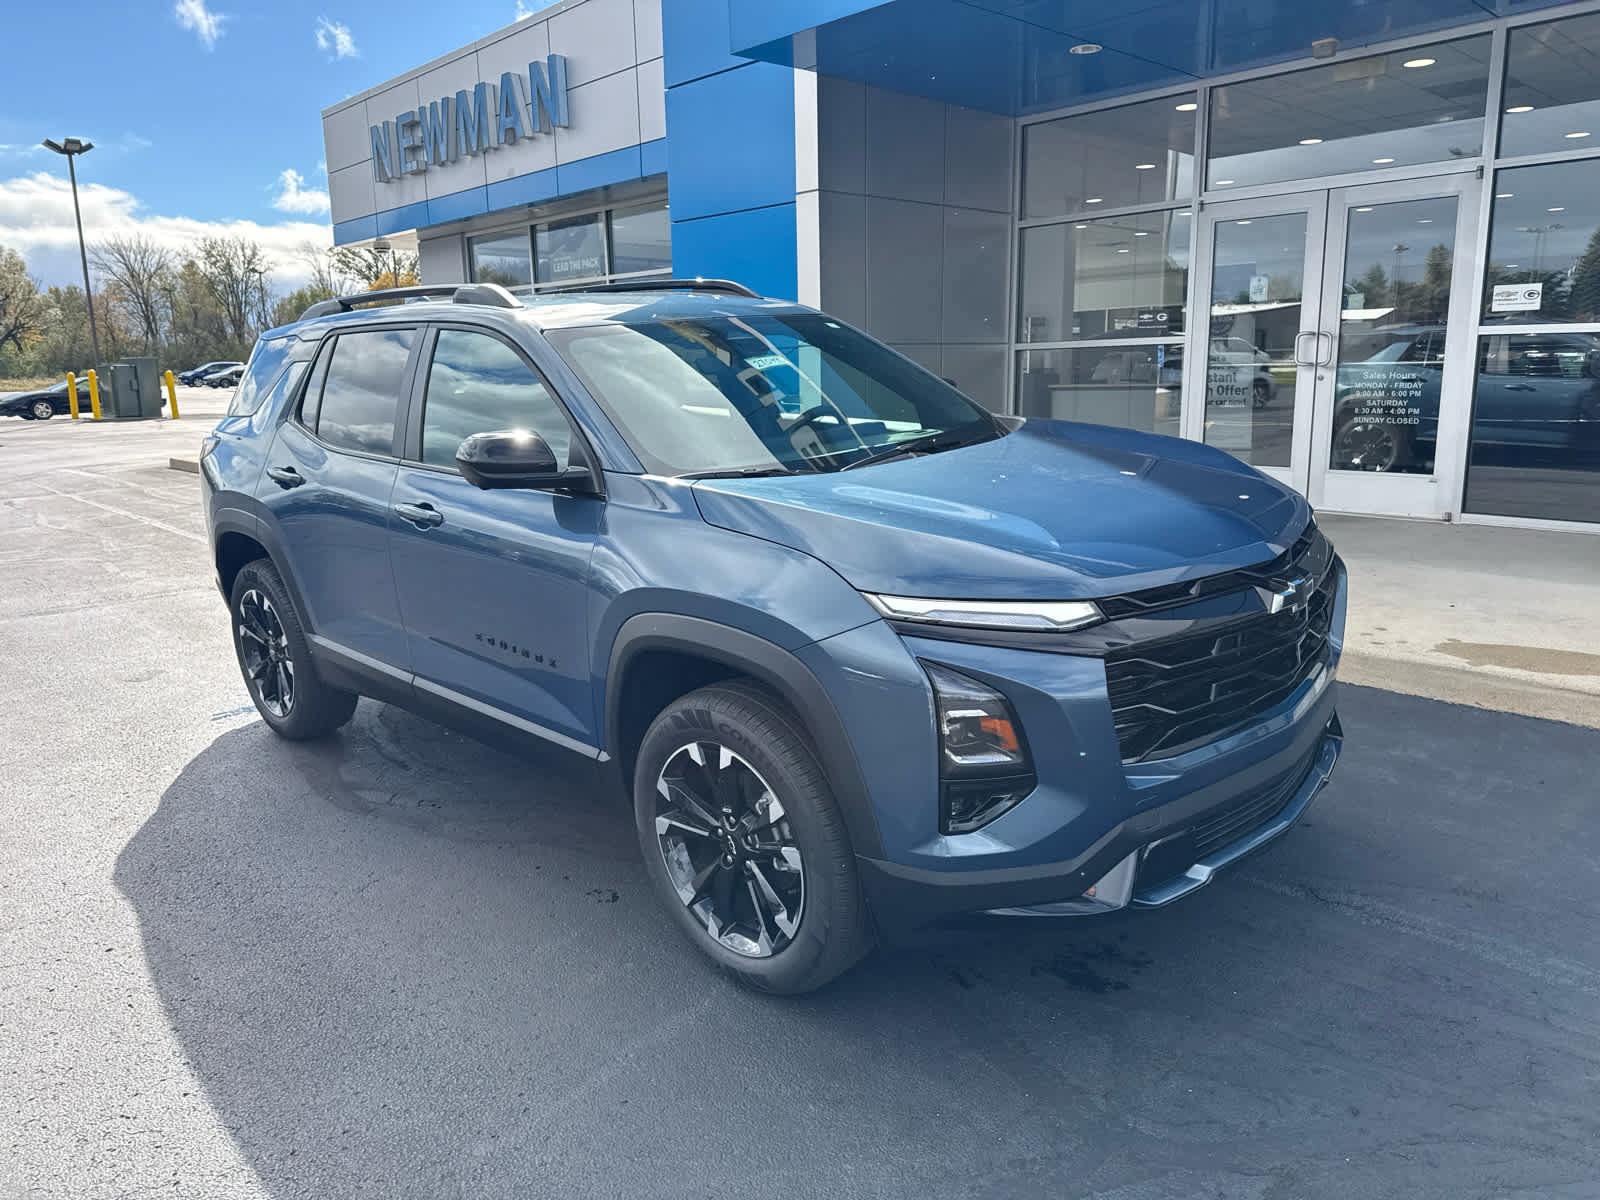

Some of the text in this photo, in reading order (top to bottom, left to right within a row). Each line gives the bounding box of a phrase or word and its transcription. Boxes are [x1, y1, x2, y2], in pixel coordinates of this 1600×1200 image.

[370, 53, 568, 183] NEWMAN
[1362, 371, 1417, 380] Sales Hours
[1216, 385, 1249, 396] Offer
